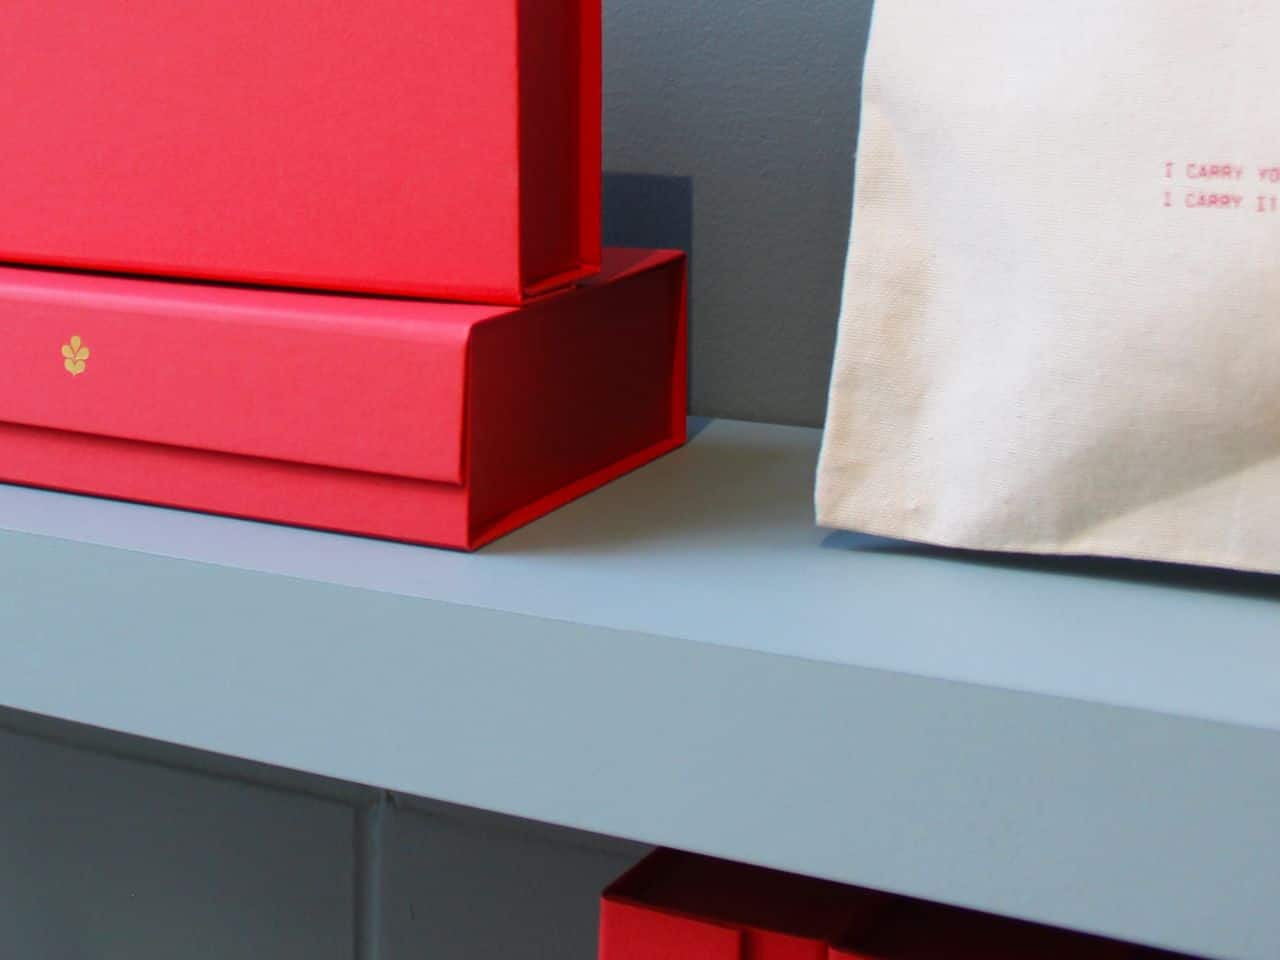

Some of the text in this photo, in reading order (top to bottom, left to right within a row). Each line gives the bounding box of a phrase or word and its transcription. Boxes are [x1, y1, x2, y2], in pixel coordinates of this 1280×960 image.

[1163, 160, 1174, 179] I
[1185, 162, 1244, 180] CARRY
[1162, 189, 1173, 207] I
[1184, 191, 1243, 209] CARRY
